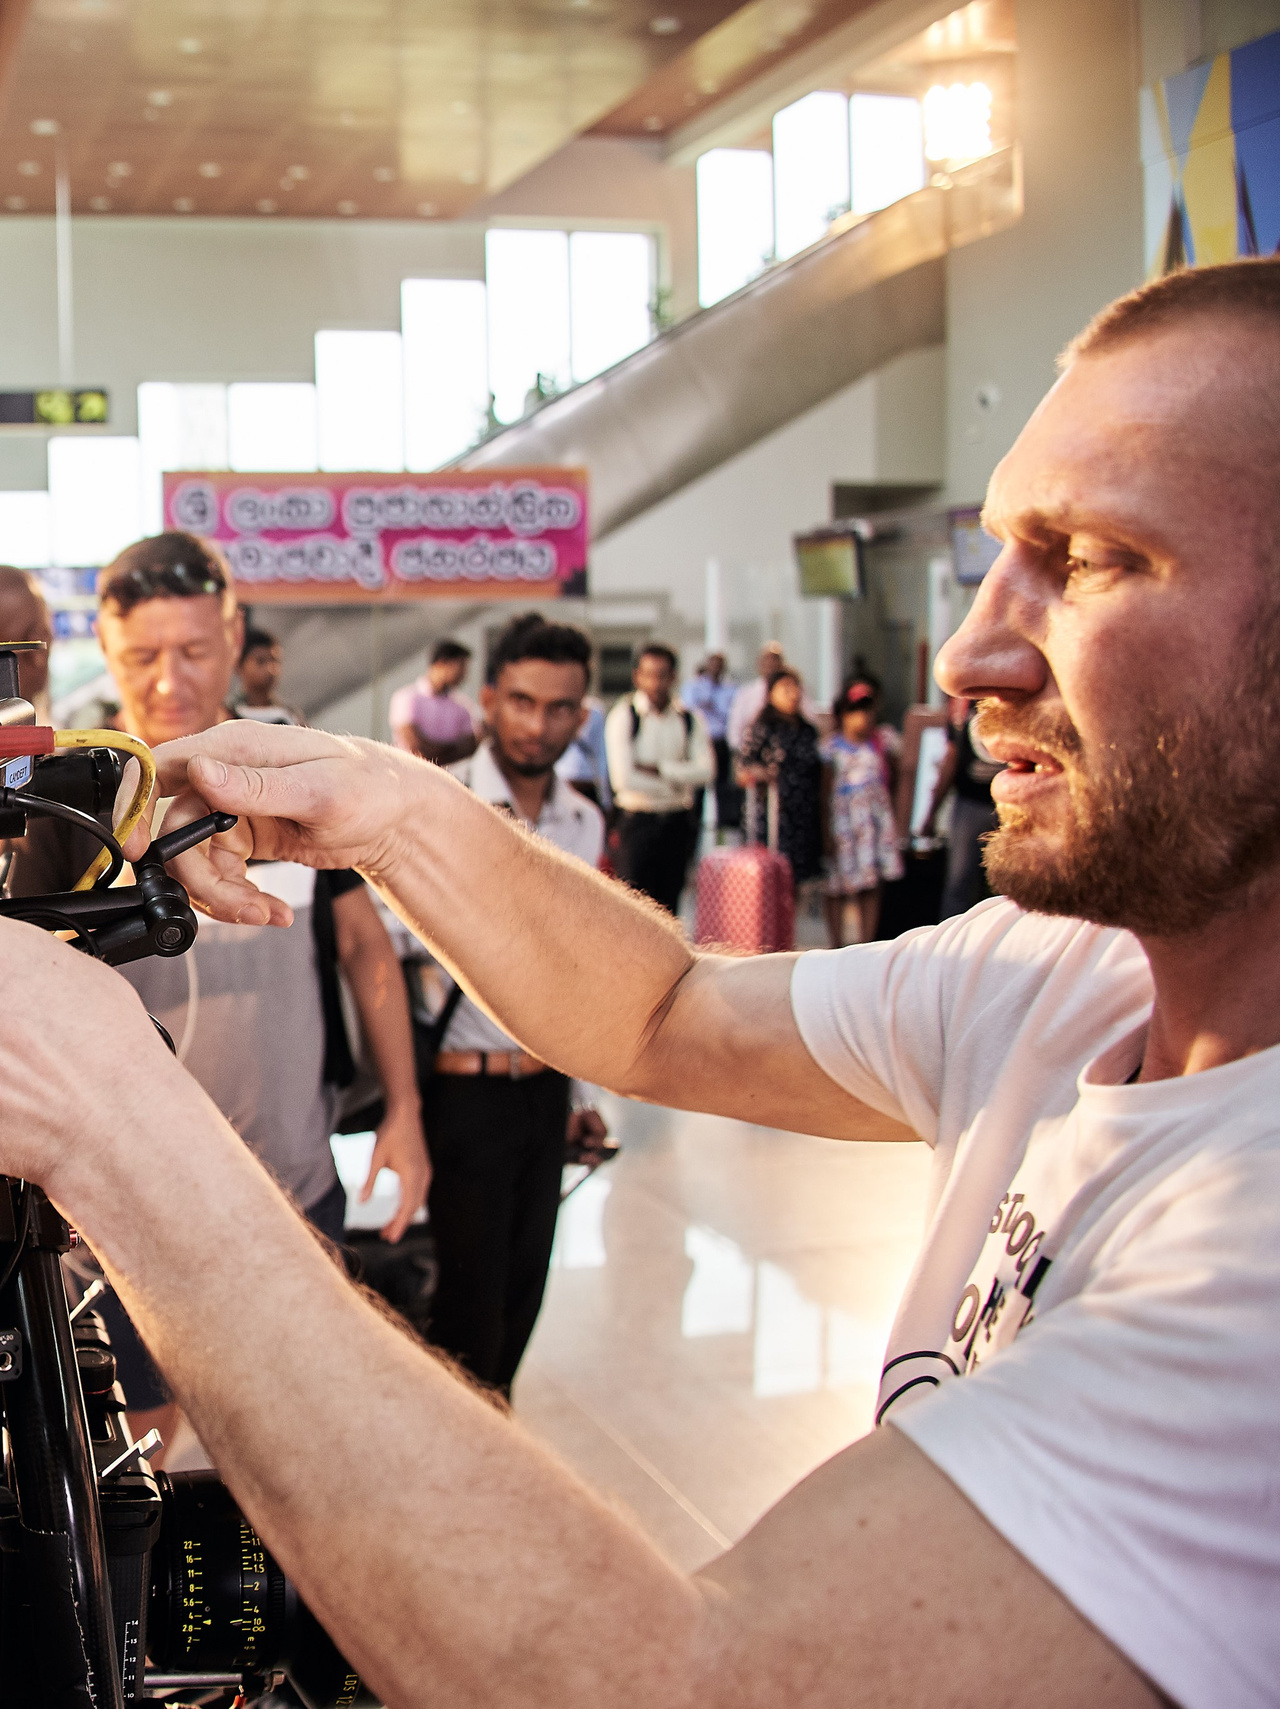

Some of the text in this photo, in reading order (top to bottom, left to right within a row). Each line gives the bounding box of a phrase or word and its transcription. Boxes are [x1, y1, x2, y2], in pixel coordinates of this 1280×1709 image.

[183, 1541, 193, 1550] 22
[185, 1555, 194, 1563] 16
[253, 1552, 264, 1562] 1.3
[253, 1564, 265, 1573] 1.5
[187, 1569, 195, 1578] 11
[189, 1584, 195, 1592] 8
[253, 1581, 260, 1591] 2
[183, 1598, 195, 1607] 5.6
[253, 1605, 260, 1613] 4
[253, 1617, 262, 1626] 10
[182, 1624, 193, 1632] 2.8
[343, 1674, 358, 1692] LDS
